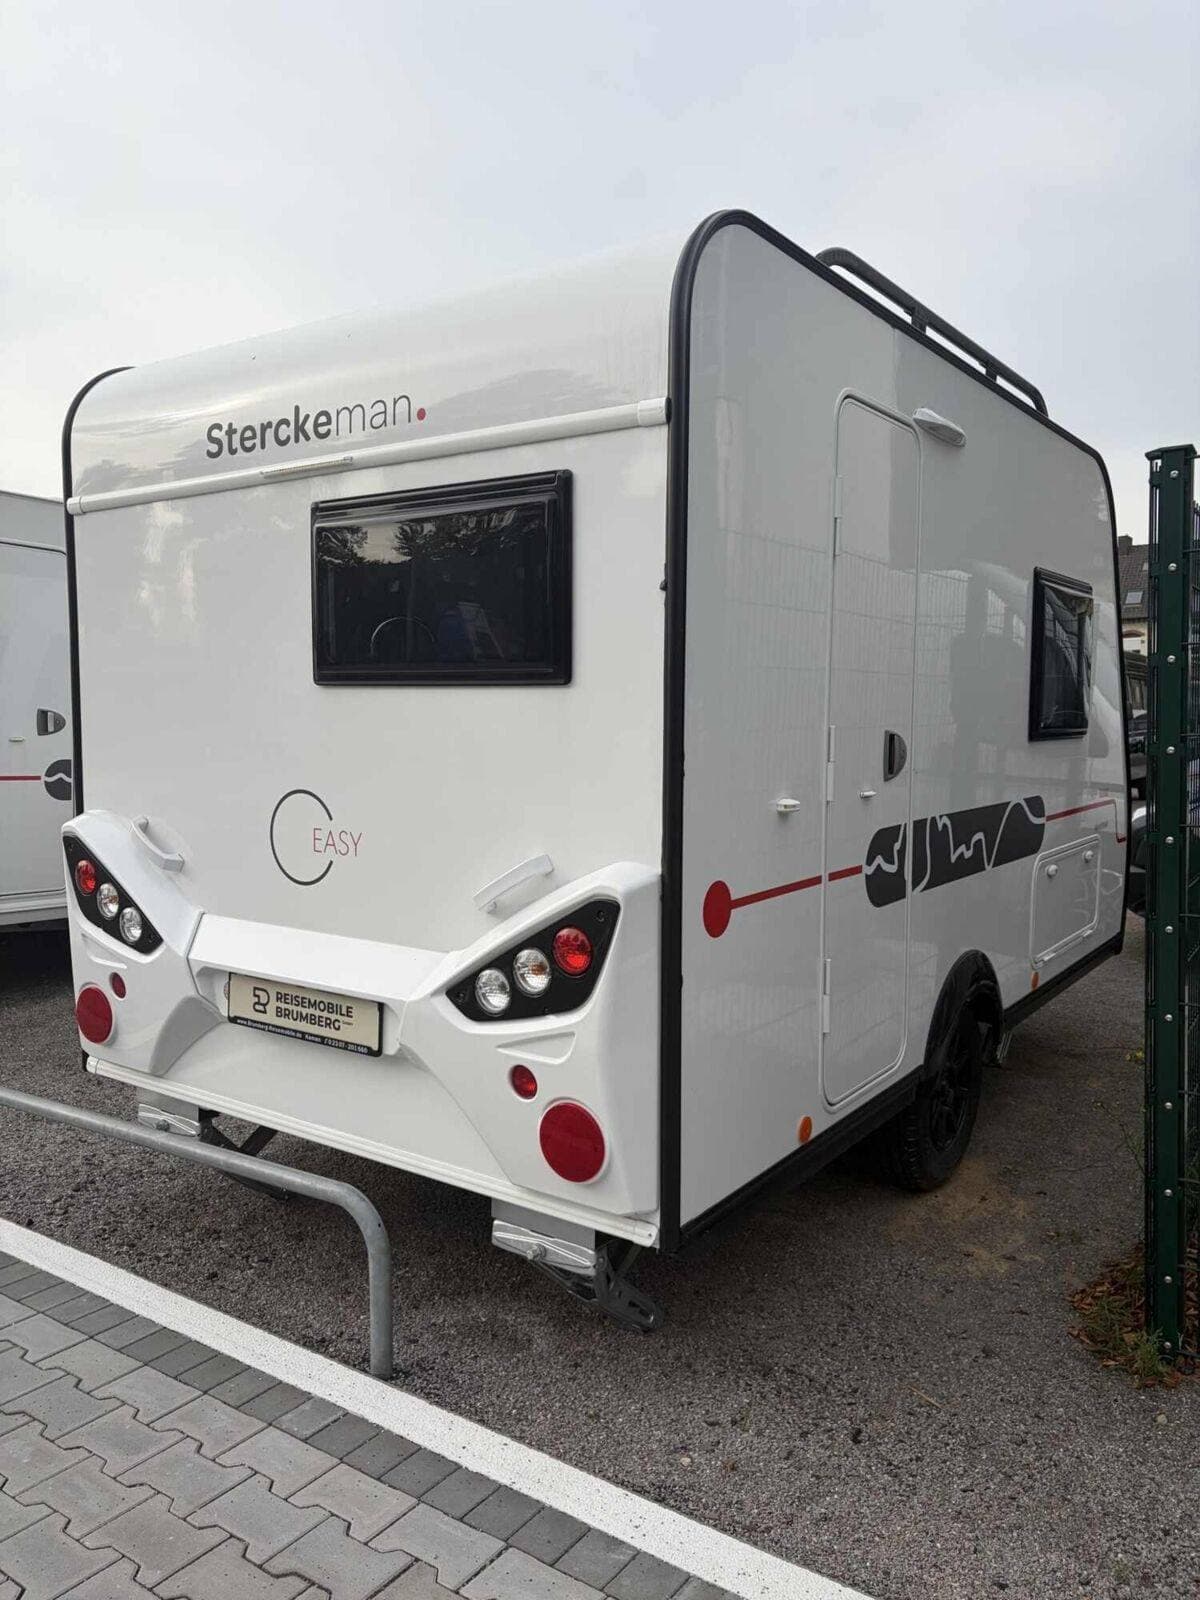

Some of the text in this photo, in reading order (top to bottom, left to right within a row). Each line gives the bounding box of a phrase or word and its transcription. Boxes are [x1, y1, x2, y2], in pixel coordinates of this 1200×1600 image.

[313, 827, 363, 857] EASY
[275, 991, 354, 1019] REISEMOBILE
[275, 1006, 341, 1031] BRUMBERG
